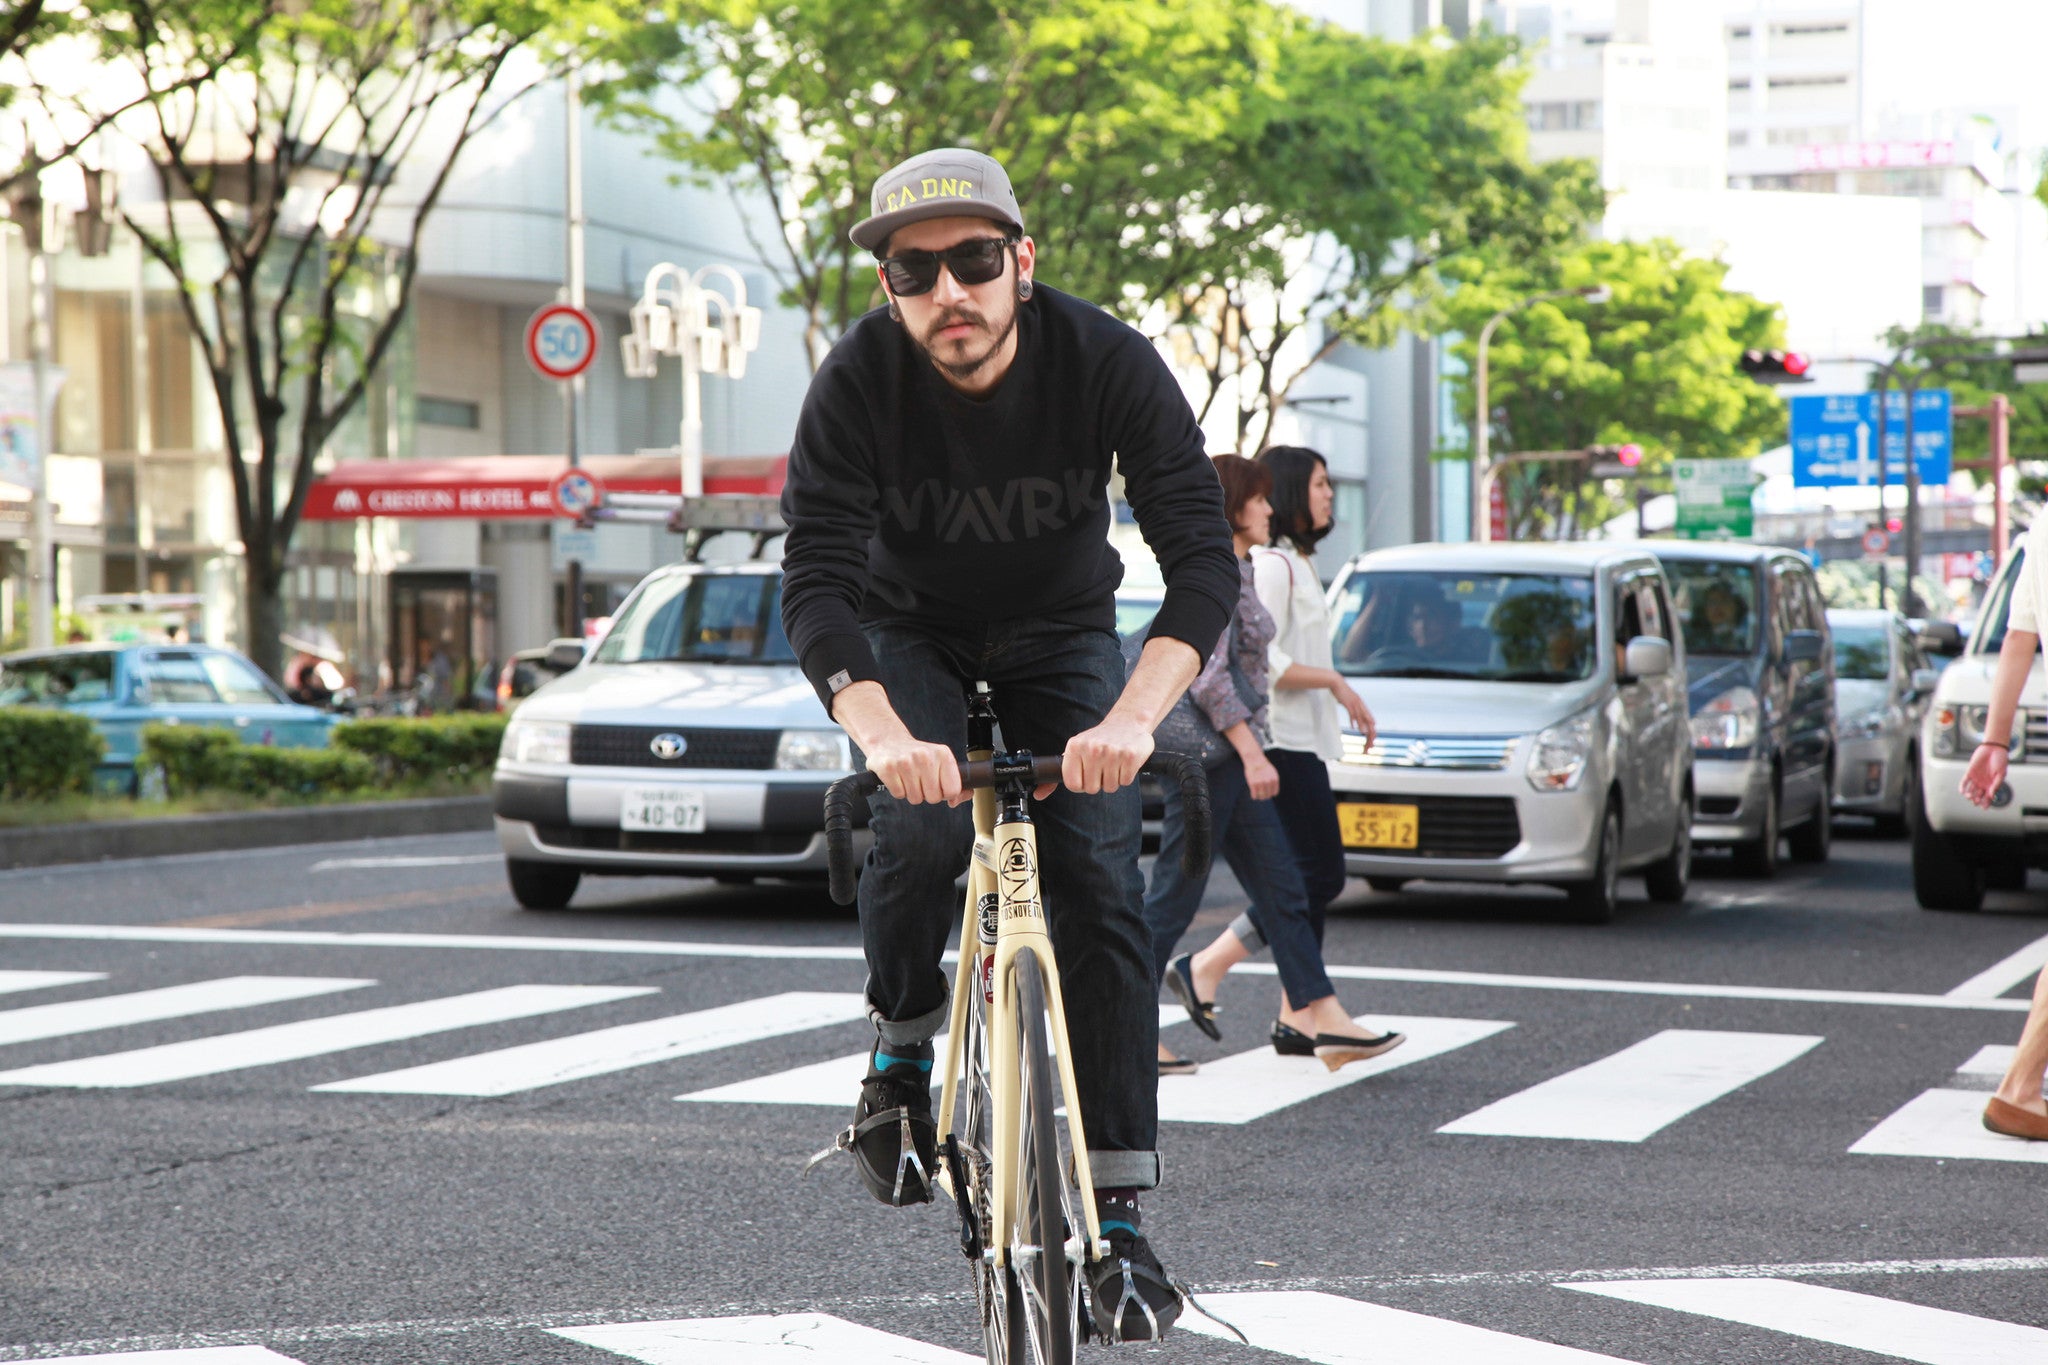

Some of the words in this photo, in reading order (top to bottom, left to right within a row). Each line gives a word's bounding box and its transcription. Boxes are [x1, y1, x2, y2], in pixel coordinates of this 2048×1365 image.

[921, 177, 973, 199] DNC
[541, 323, 584, 360] 50
[459, 487, 528, 510] HOTEL
[995, 764, 1029, 774] THOMSON
[640, 805, 699, 826] 40-07
[1355, 821, 1413, 844] 55-12
